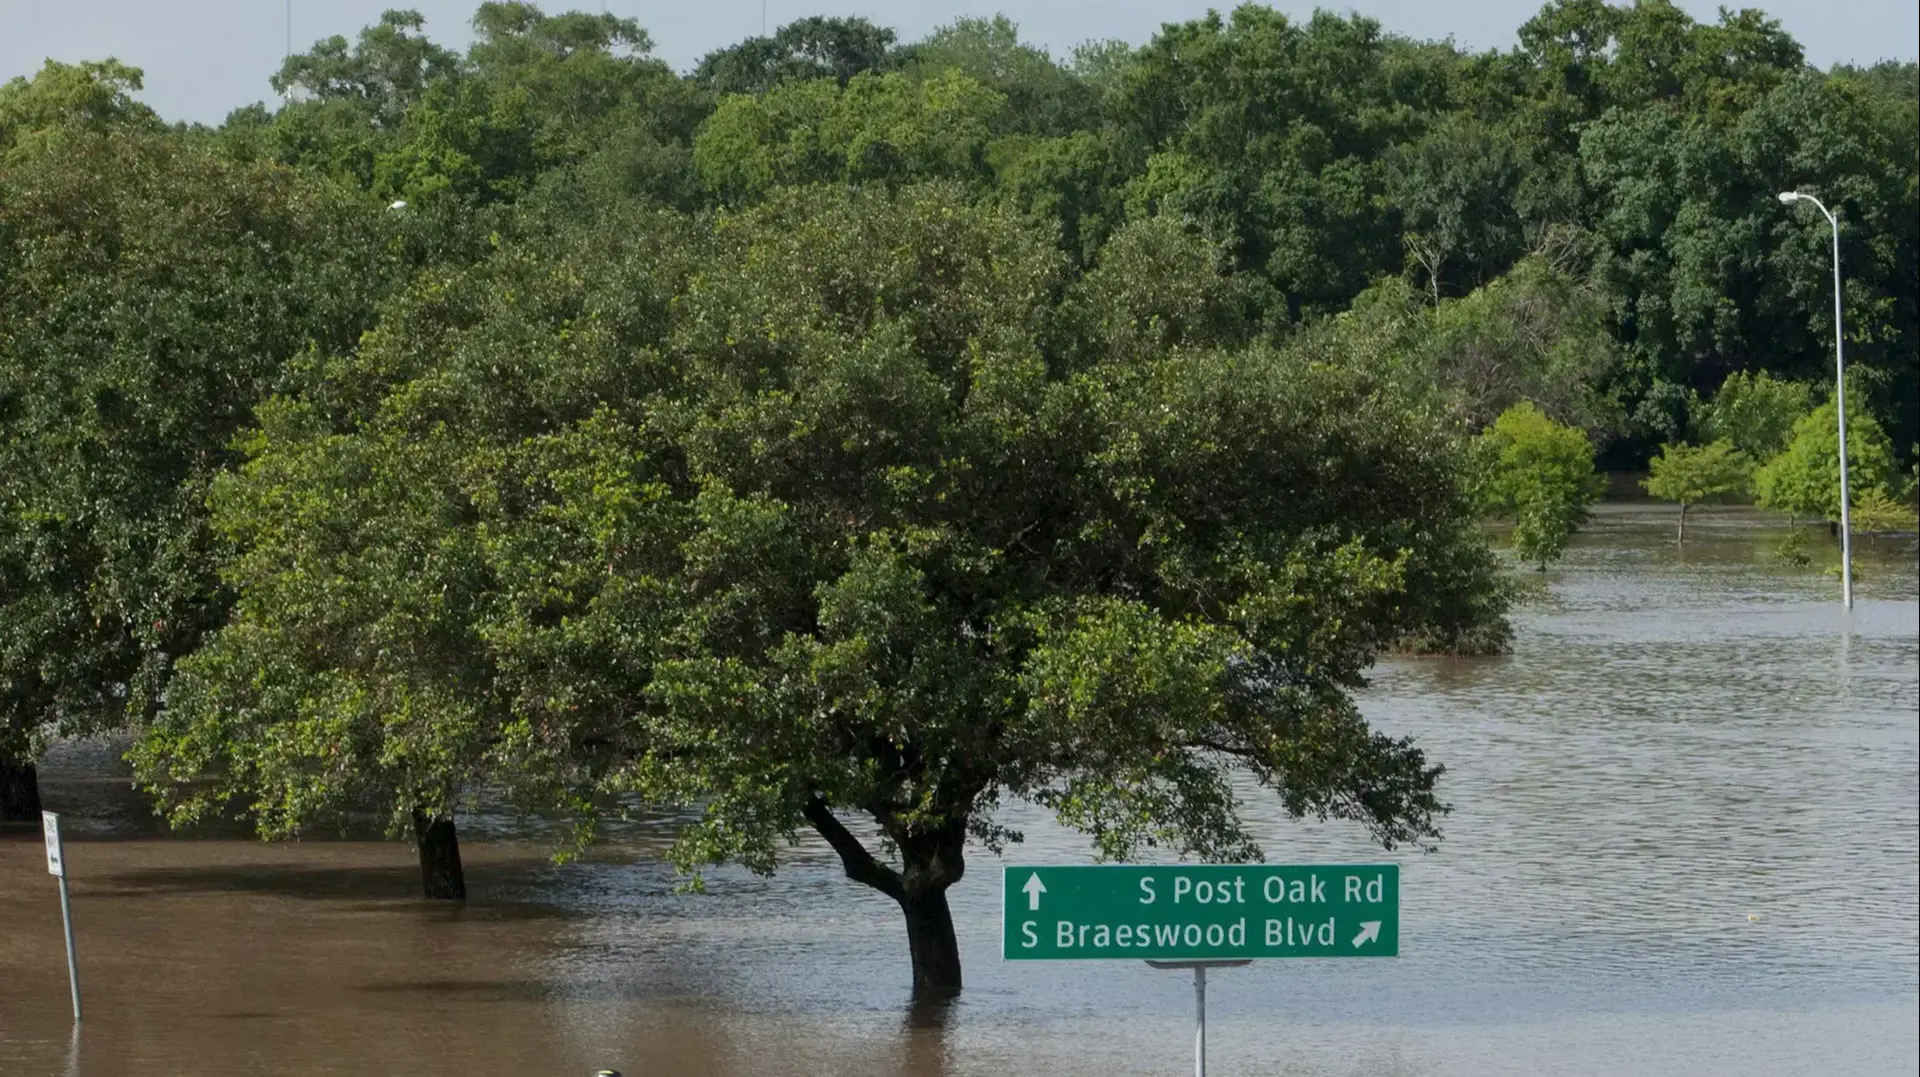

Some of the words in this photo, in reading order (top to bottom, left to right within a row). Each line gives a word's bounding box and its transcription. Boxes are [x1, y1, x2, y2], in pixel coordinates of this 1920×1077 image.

[1139, 876, 1156, 904] S
[1174, 876, 1246, 903] Post
[1263, 874, 1327, 903] Oak
[1344, 874, 1383, 903] Rd
[1021, 920, 1039, 948] S
[1056, 917, 1246, 947] Braeswood
[1264, 917, 1336, 946] Blvd
